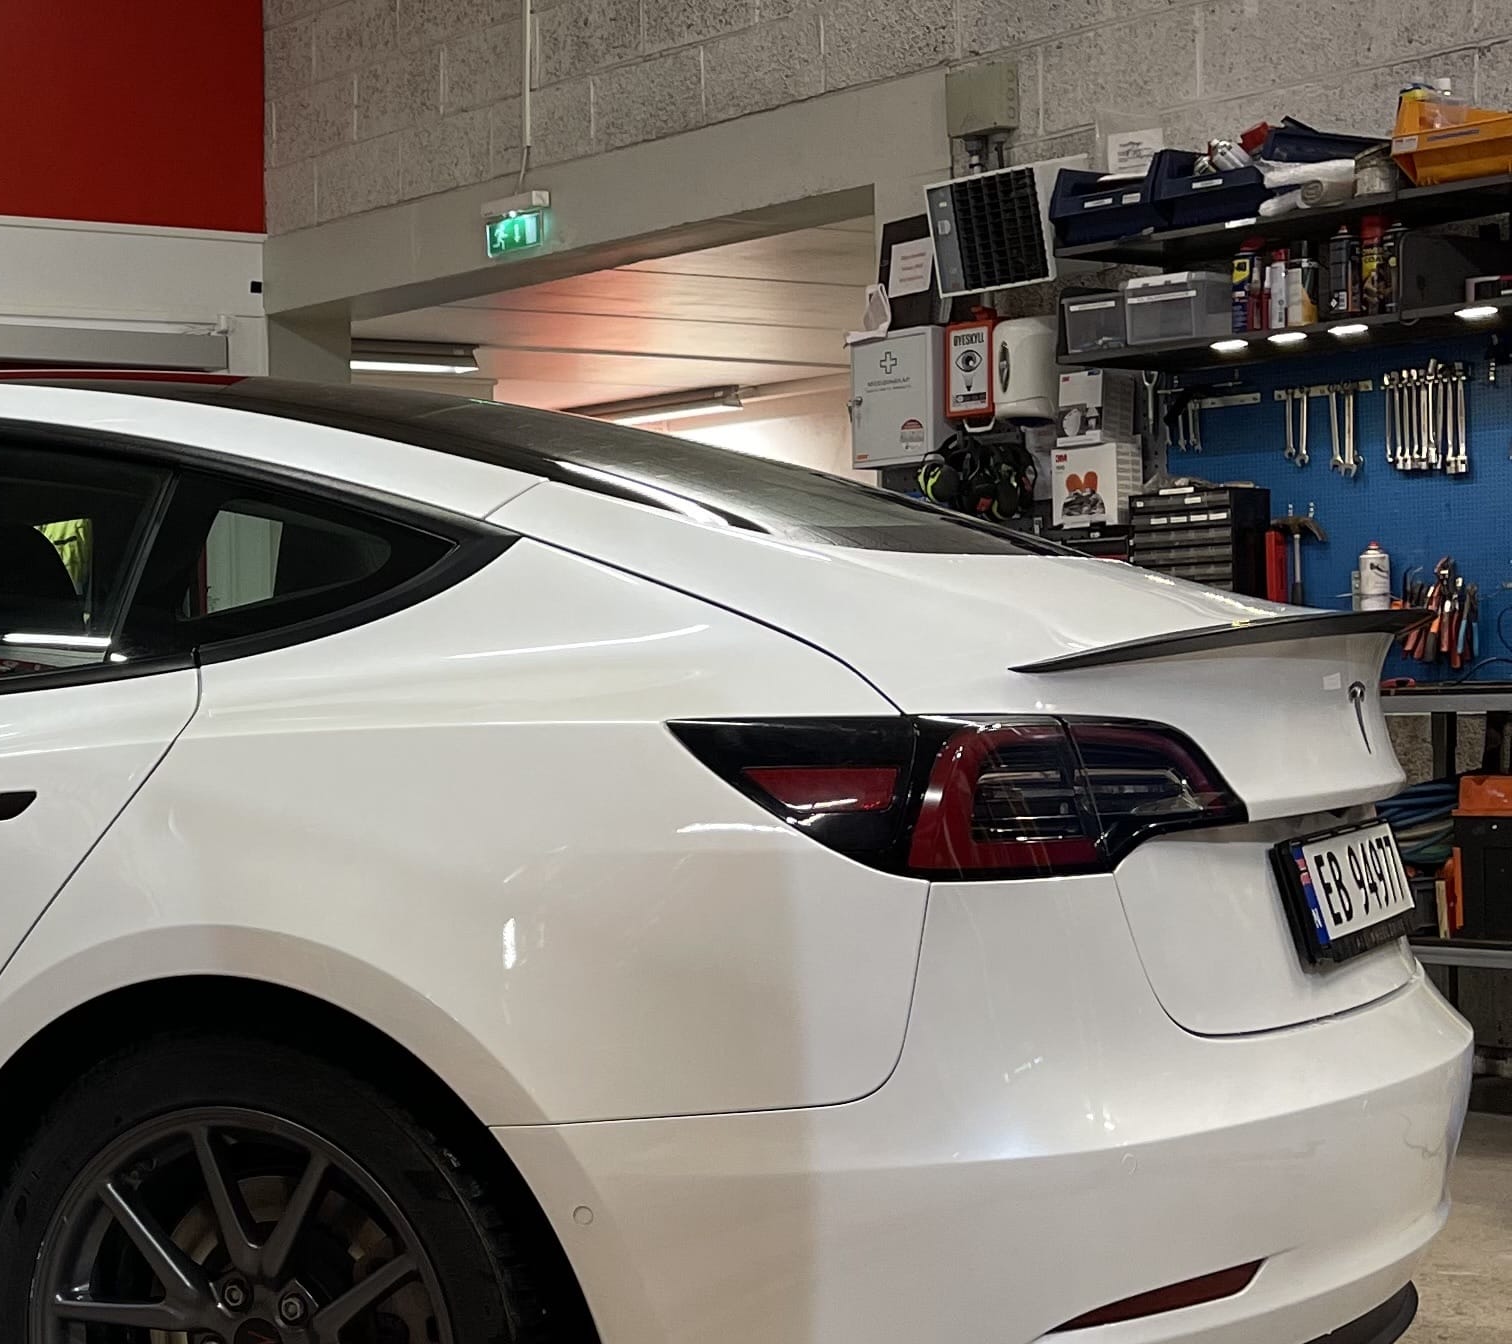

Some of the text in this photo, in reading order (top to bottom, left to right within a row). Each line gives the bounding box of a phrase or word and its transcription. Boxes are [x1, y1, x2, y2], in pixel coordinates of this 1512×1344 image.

[1055, 454, 1068, 463] 3M
[1314, 835, 1405, 926] EB 94977
[1311, 907, 1323, 929] N
